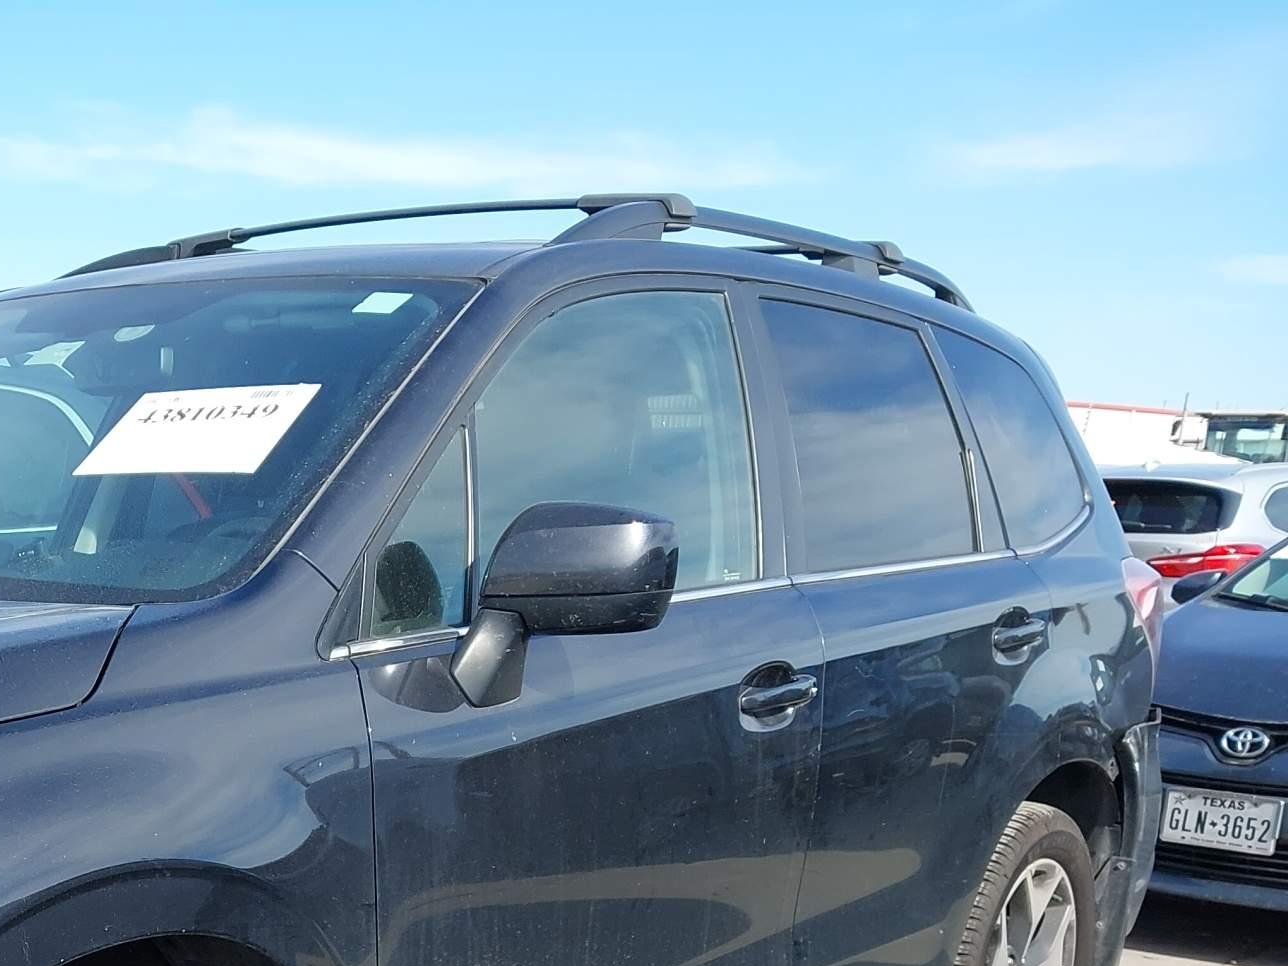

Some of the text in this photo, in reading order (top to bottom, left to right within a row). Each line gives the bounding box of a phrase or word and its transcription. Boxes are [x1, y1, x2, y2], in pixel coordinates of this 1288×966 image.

[137, 403, 279, 424] 43810349
[1203, 797, 1245, 810] TEXAS
[1168, 807, 1209, 835] GLN
[1218, 813, 1271, 844] 3652
